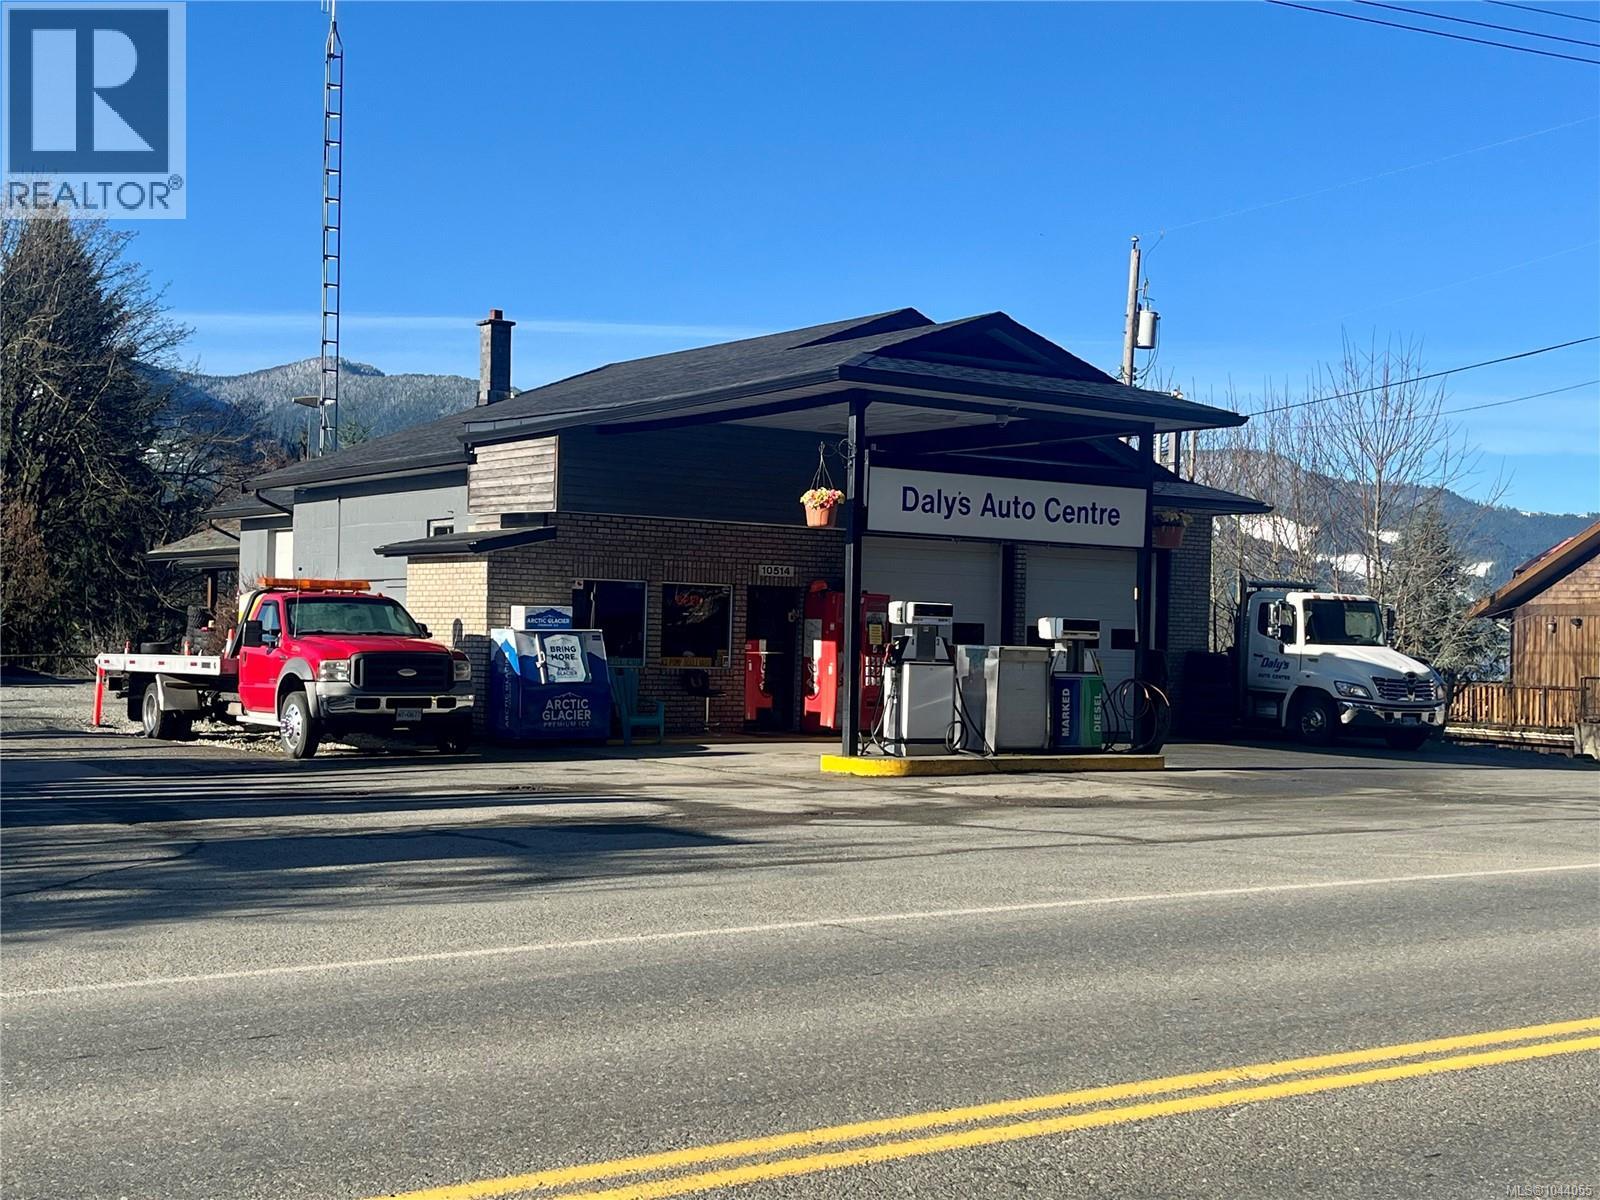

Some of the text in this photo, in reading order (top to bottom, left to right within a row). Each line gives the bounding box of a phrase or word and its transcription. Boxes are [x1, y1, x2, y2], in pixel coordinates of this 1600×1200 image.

[901, 485, 1121, 526] Daly's Auto Centre
[762, 566, 790, 576] 10514
[550, 645, 577, 653] BRING
[551, 653, 575, 661] MORE
[1261, 657, 1290, 672] Daly's
[545, 699, 589, 710] ARCTIC
[542, 710, 592, 721] GLACIER
[1061, 687, 1070, 737] MARKED
[1093, 692, 1102, 732] DIESEL
